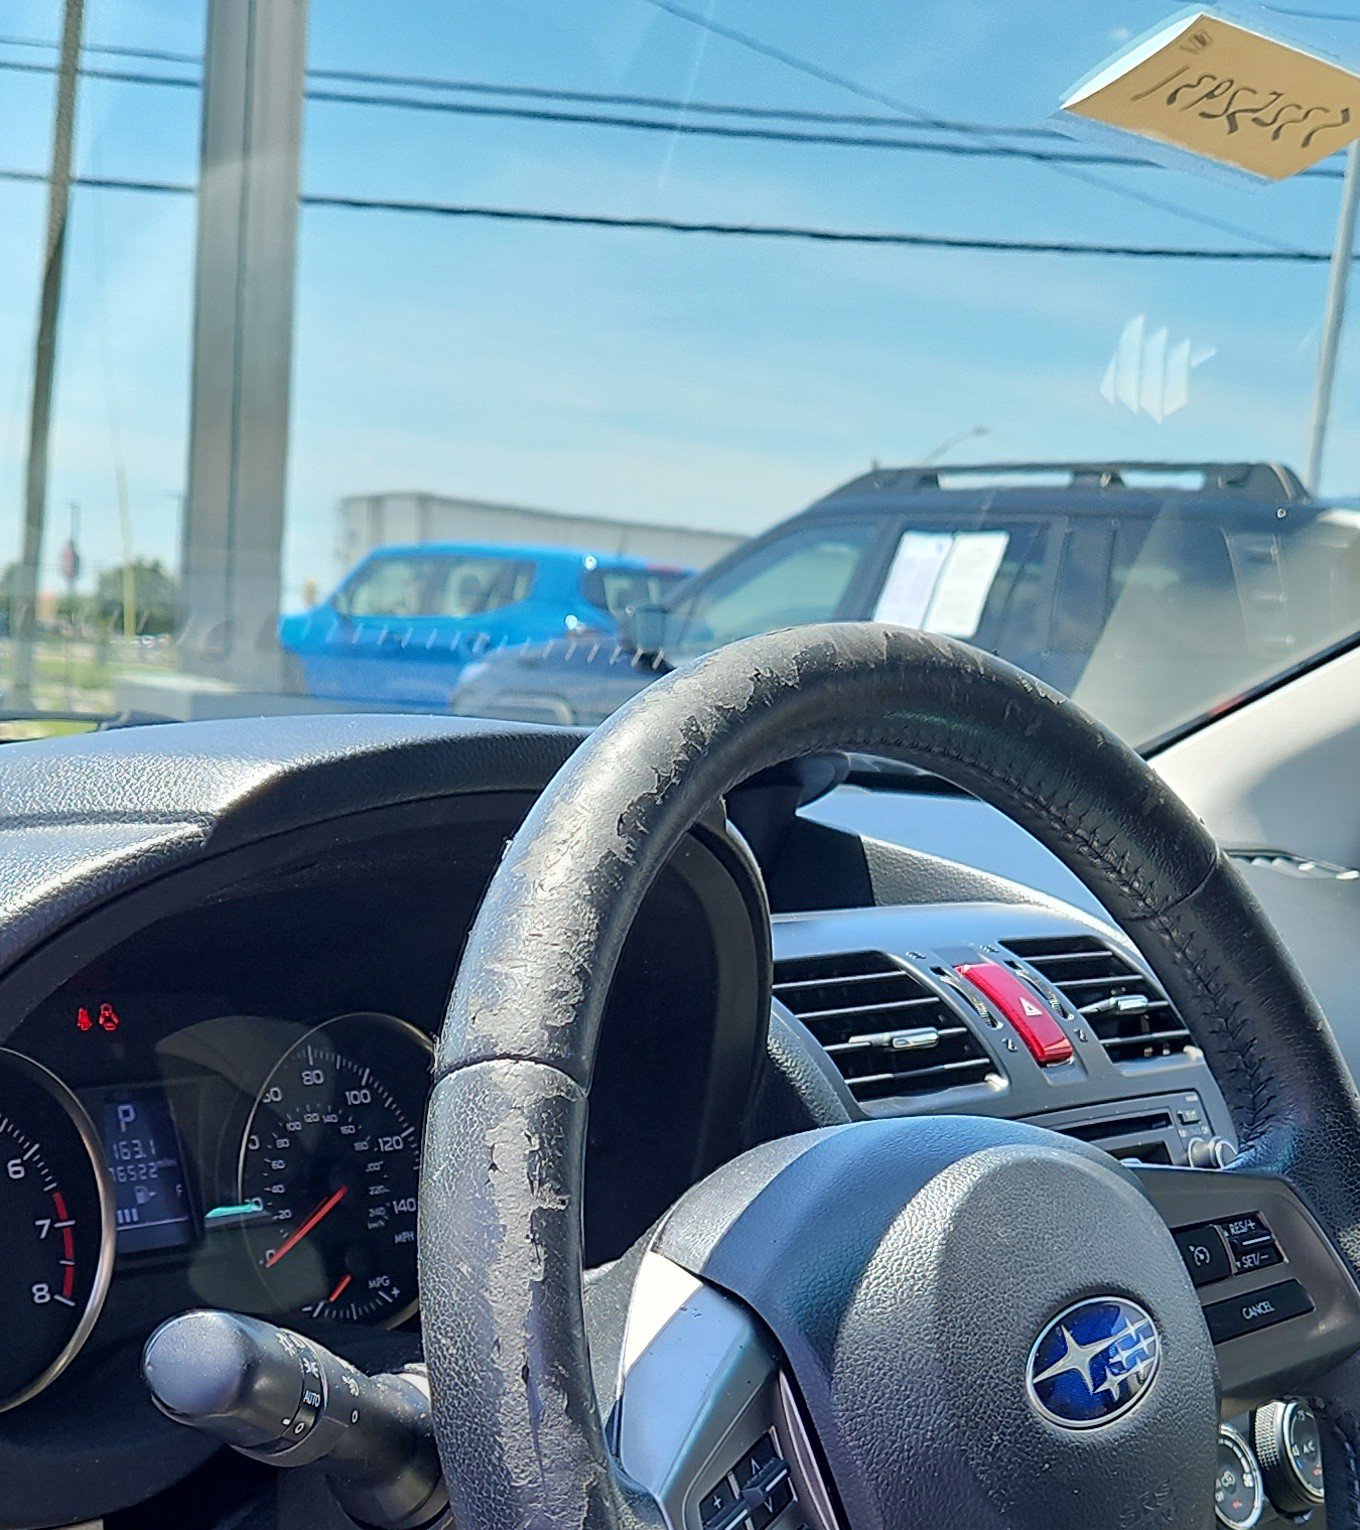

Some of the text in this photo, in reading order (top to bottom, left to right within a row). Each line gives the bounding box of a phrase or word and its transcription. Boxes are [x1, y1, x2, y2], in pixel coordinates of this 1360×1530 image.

[301, 1070, 324, 1085] 80
[345, 1089, 371, 1106] 100
[117, 1104, 136, 1133] P
[378, 1136, 404, 1152] 120
[7, 1159, 26, 1179] 6
[392, 1198, 417, 1214] 140
[35, 1218, 51, 1239] 7
[394, 1231, 415, 1243] MPH
[368, 1275, 391, 1288] MPG
[32, 1283, 51, 1304] 8
[1242, 1301, 1275, 1321] CANCEL
[303, 1390, 321, 1408] AUTO
